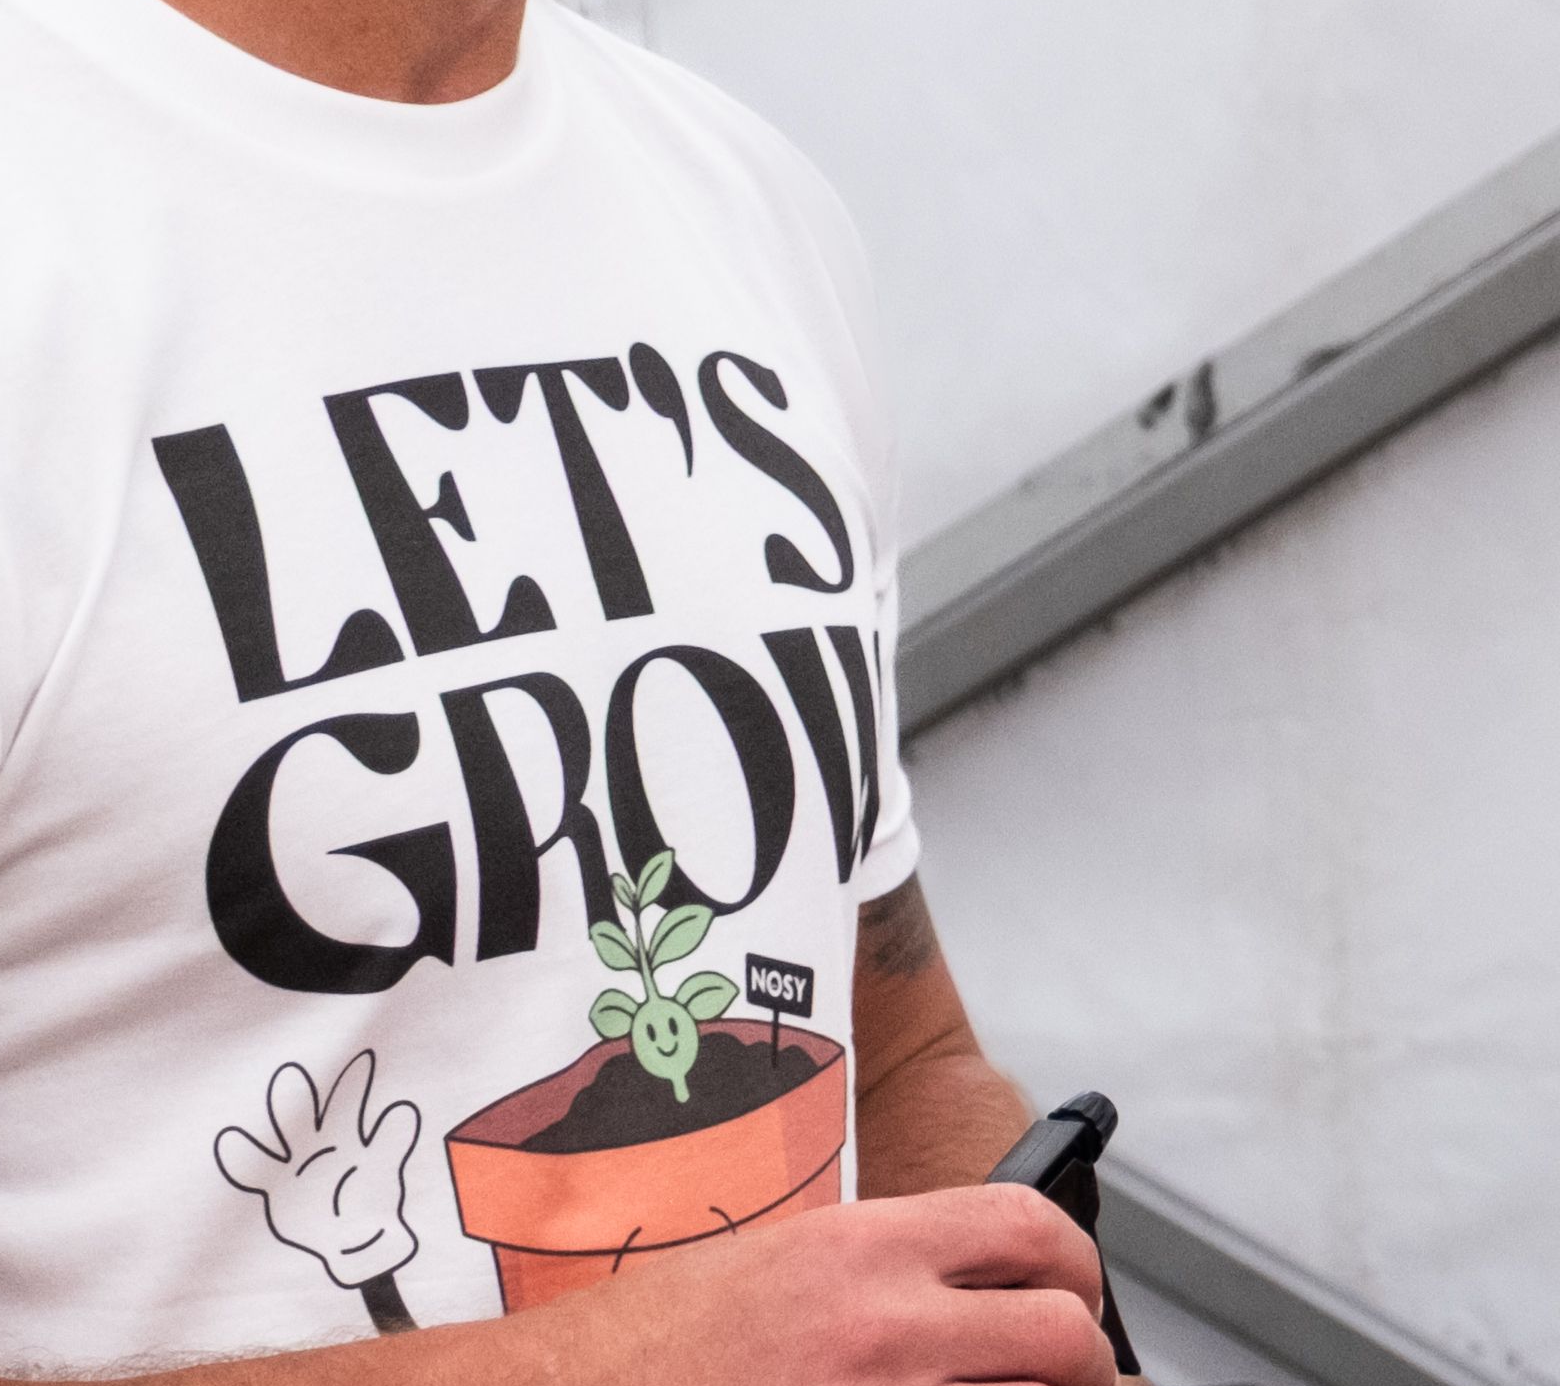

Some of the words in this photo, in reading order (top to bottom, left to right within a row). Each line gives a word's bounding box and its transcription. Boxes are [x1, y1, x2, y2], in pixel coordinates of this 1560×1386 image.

[152, 342, 854, 703] LET'S
[206, 625, 882, 995] GROW
[751, 965, 807, 1003] NOSY
